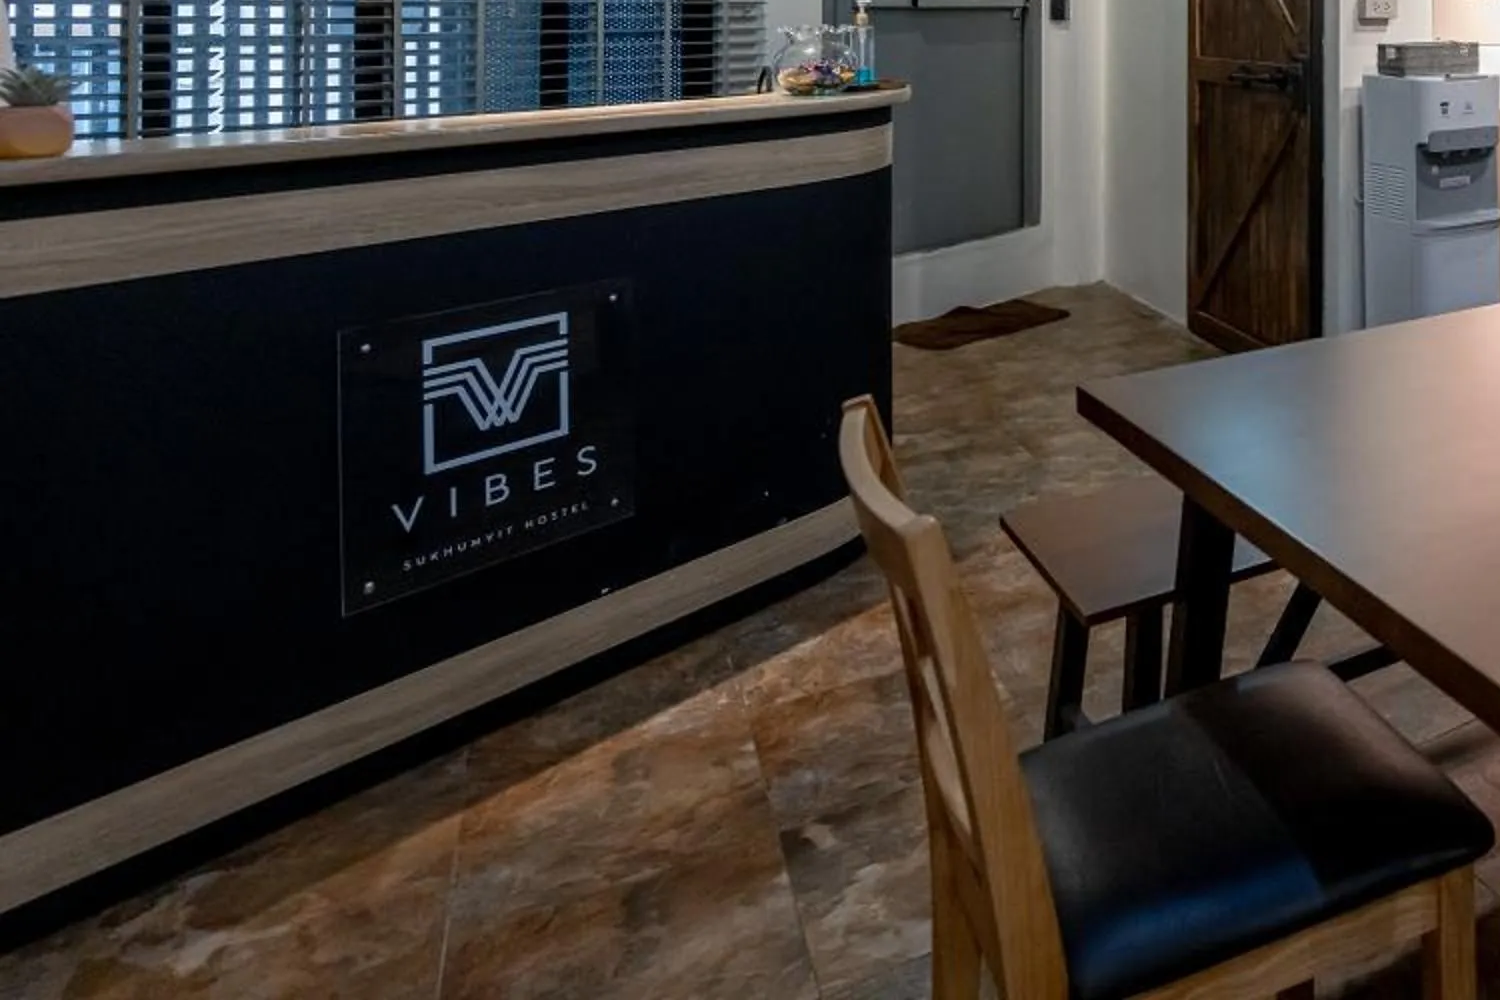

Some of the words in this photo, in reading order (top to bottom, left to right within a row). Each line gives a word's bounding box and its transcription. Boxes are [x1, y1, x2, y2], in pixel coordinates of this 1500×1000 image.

[391, 445, 598, 533] VIBES
[402, 525, 514, 572] SUKHUMVIT
[524, 501, 590, 530] HOSTEL
